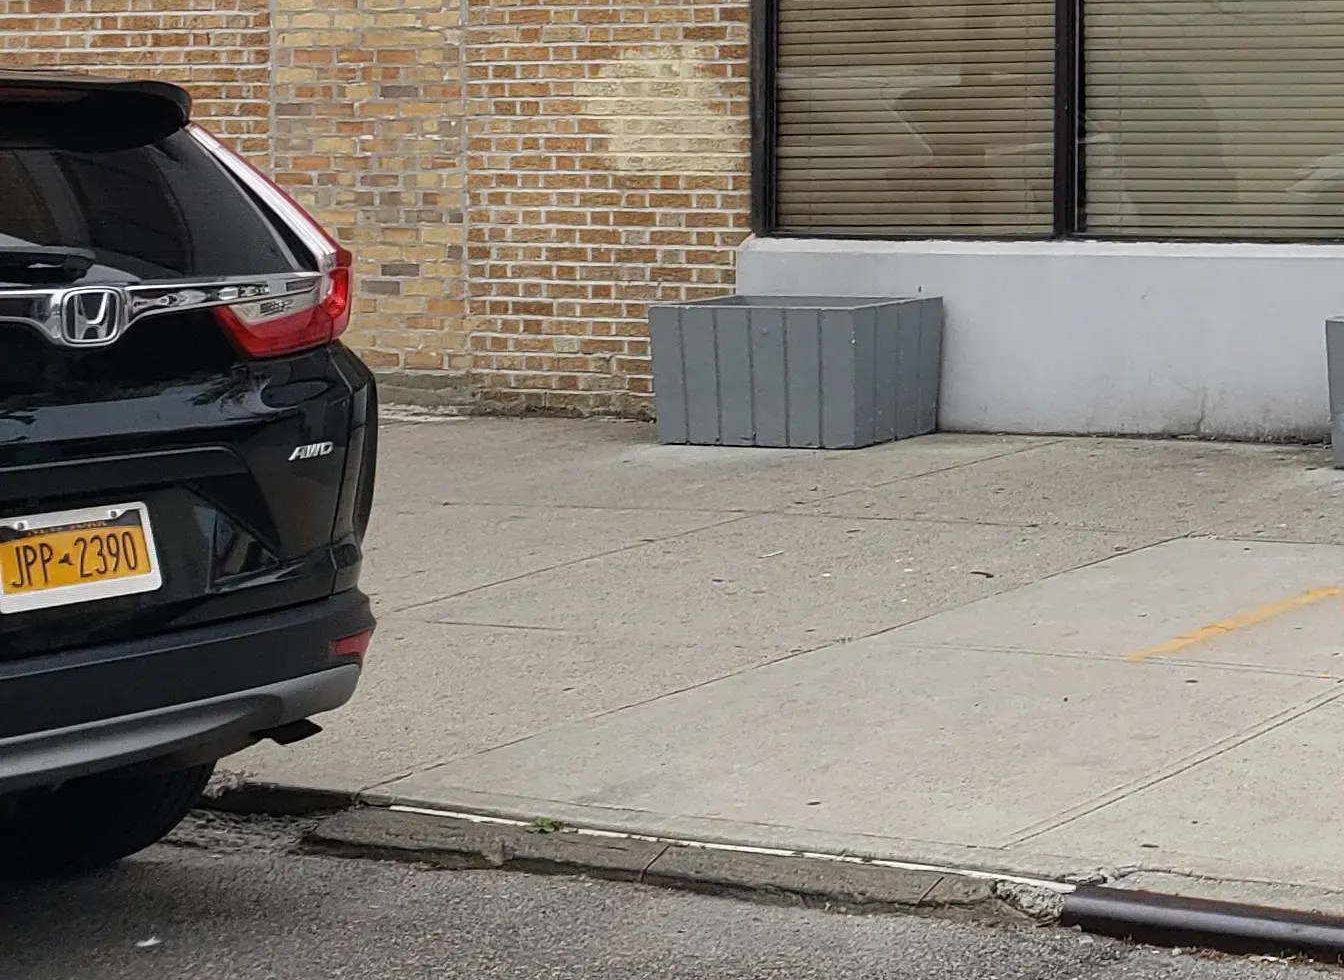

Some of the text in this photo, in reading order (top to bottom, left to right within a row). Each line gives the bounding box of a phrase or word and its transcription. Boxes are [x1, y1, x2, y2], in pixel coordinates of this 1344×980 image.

[288, 441, 334, 461] AWD
[12, 531, 137, 587] JPP 2390
